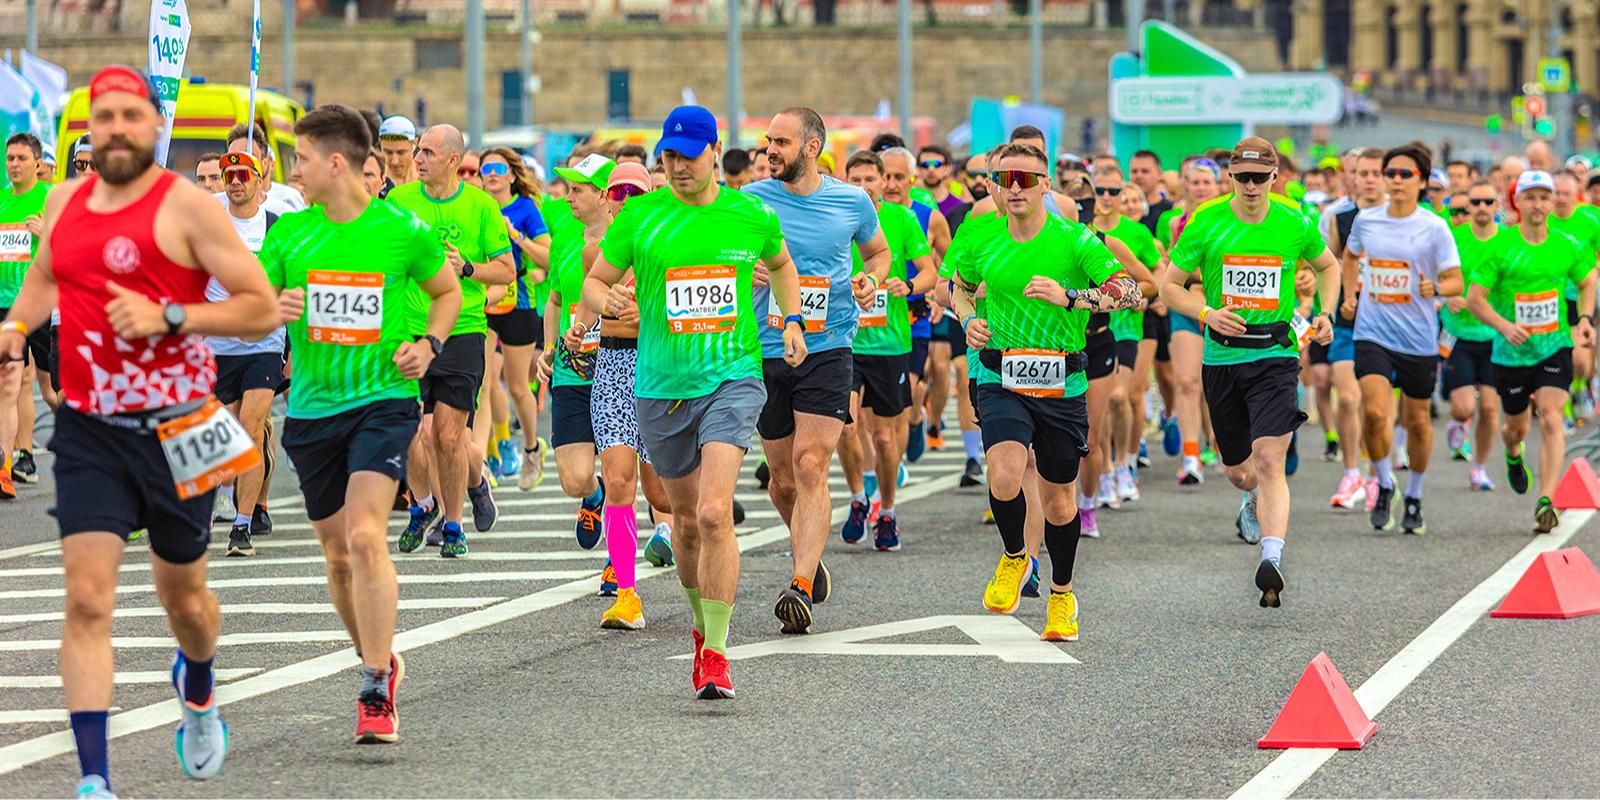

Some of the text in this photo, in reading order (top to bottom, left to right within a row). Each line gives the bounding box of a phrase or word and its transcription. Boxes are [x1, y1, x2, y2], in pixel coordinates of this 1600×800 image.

[0, 233, 29, 246] 2846
[1226, 270, 1276, 288] 12031
[1370, 273, 1409, 288] 11467
[312, 291, 379, 315] 12143
[671, 284, 733, 306] 11986
[689, 305, 717, 313] МАТВЕЙ
[1518, 301, 1556, 319] 12212
[1005, 360, 1060, 378] 12671
